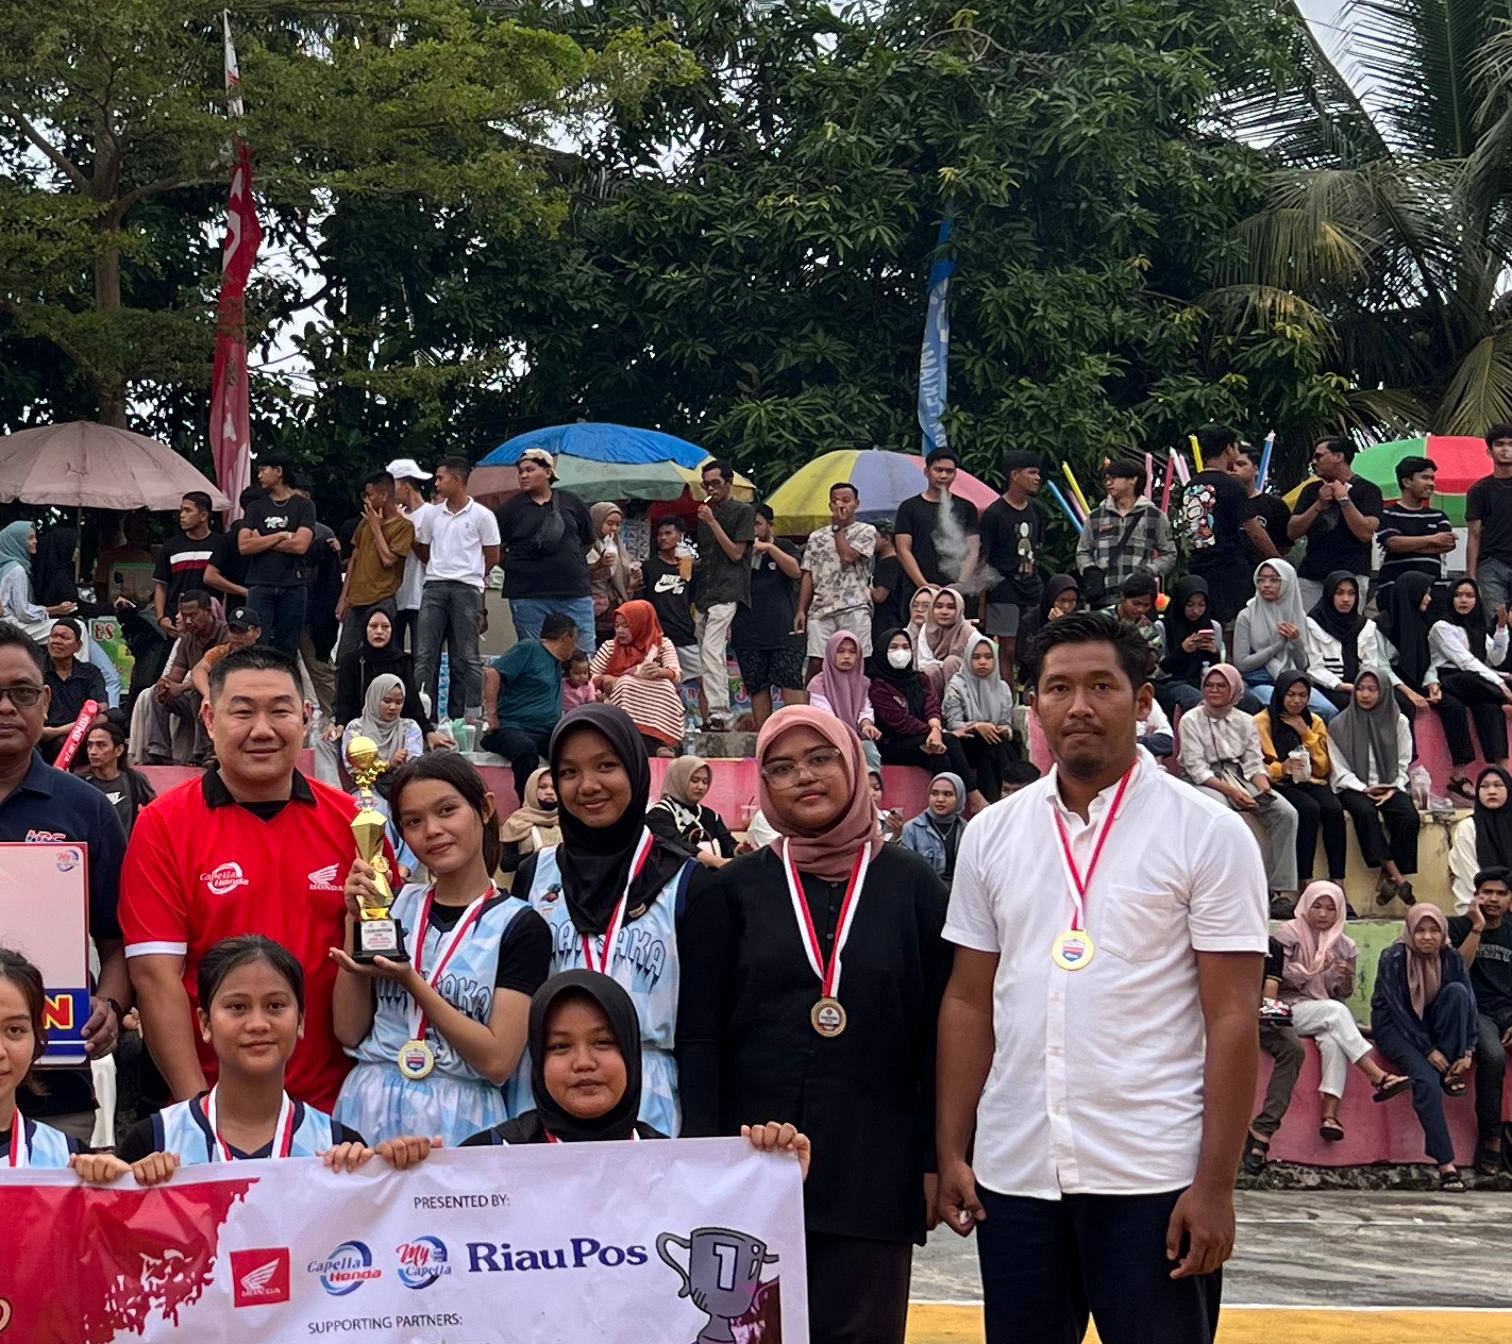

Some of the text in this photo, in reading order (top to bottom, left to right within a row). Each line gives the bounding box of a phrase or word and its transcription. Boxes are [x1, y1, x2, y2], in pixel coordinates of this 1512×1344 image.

[413, 1193, 511, 1209] PRESENTED BY:
[306, 1256, 362, 1275] Capella
[328, 1268, 382, 1282] Honda
[241, 1287, 281, 1297] HONDA
[308, 1313, 463, 1334] SUPPORTING PARTNERS:
